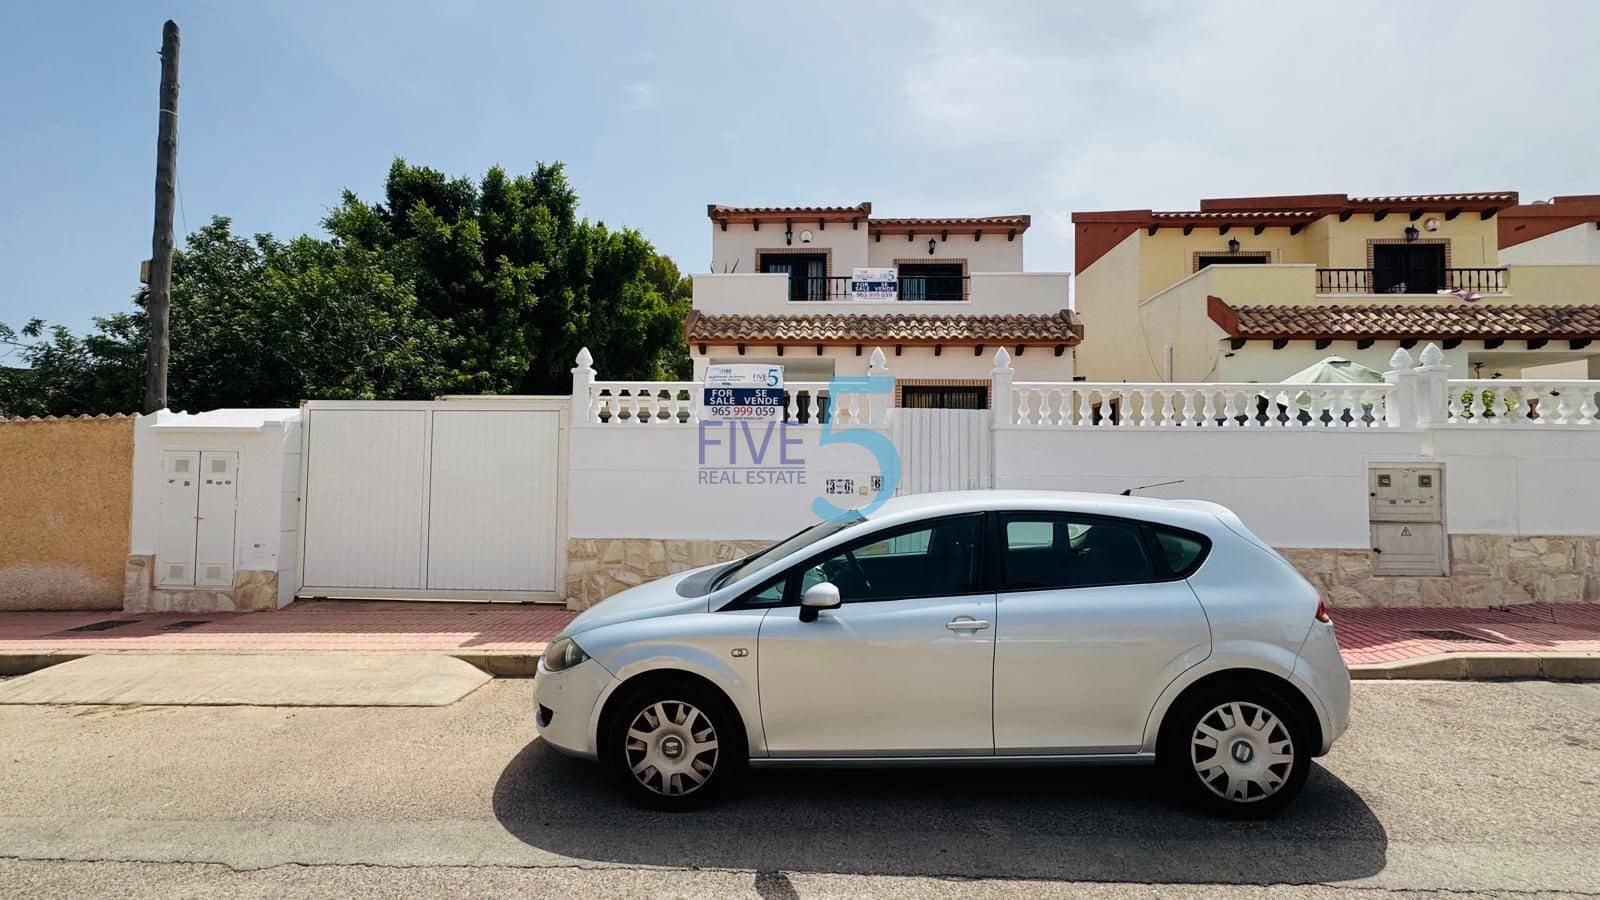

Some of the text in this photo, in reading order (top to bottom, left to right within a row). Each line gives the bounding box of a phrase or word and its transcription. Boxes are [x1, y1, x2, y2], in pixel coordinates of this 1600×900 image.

[887, 270, 895, 281] 5
[767, 368, 779, 387] 5
[711, 389, 768, 397] FOR SE
[709, 397, 779, 405] SALE VENDE
[711, 406, 776, 416] 965 999 059
